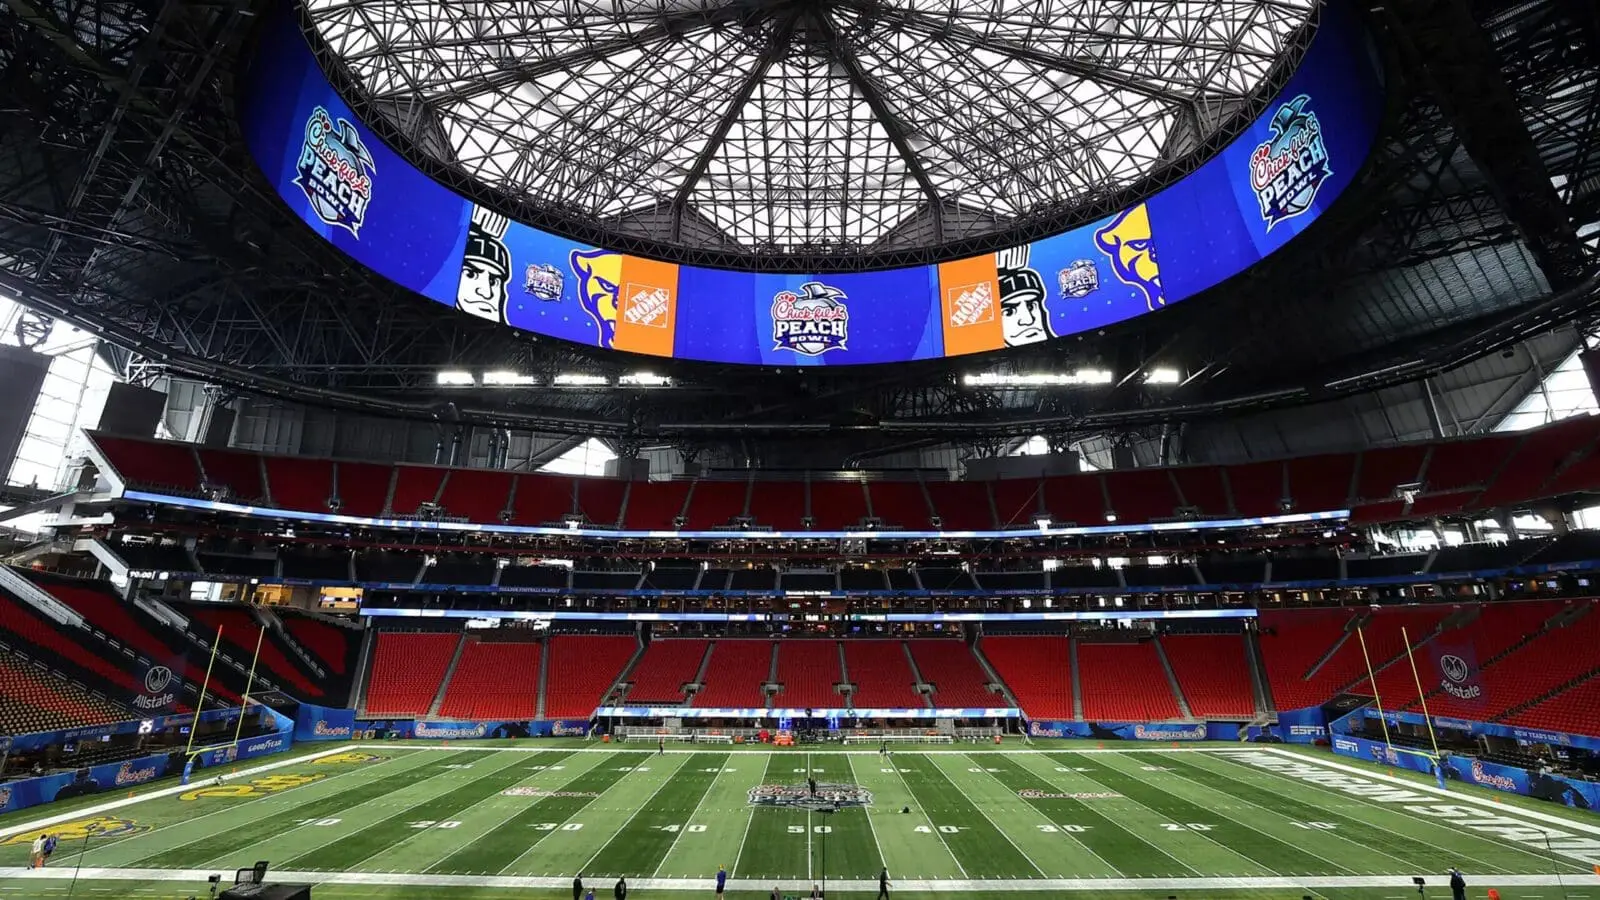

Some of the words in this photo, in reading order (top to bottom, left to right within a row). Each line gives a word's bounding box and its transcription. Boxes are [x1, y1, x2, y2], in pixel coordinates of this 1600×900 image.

[300, 143, 364, 218] PEACH
[1260, 136, 1325, 213] PEACH
[309, 178, 346, 217] BOWL
[1279, 173, 1316, 210] BOWL
[527, 279, 560, 293] PEACH
[1063, 276, 1096, 291] PEACH
[625, 288, 668, 323] HOME
[952, 283, 989, 326] HOME
[776, 321, 844, 338] PEACH
[132, 693, 174, 709] Allstate
[139, 720, 154, 733] 25
[1290, 725, 1325, 735] ESPN
[248, 740, 283, 752] GOODYEAR
[1335, 739, 1358, 752] ESPN
[410, 820, 462, 828] 20
[534, 823, 584, 831] 30
[660, 824, 708, 832] 40
[787, 825, 832, 833] 50
[914, 825, 960, 833] 40
[1036, 824, 1086, 832] 30
[1160, 823, 1212, 831] 20
